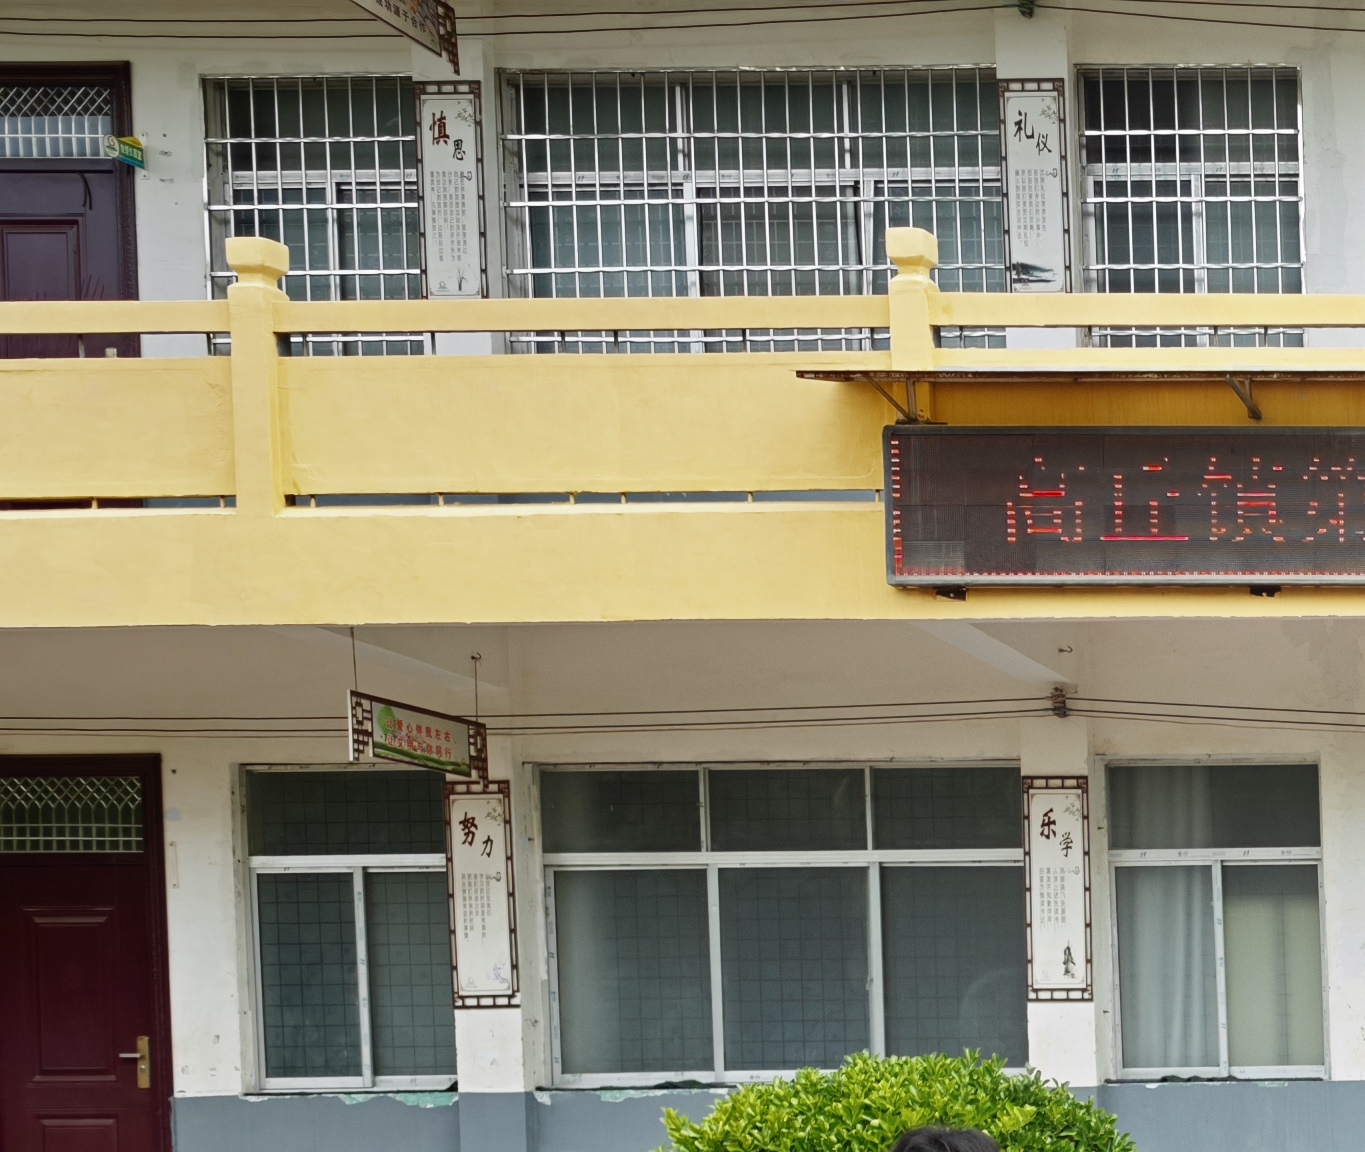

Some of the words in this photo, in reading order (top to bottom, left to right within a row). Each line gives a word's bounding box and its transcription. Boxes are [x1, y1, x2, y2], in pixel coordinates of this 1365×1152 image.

[429, 110, 466, 161] 慎思
[1013, 109, 1052, 156] 礼仪
[458, 811, 495, 858] 努力
[1039, 807, 1074, 858] 乐学
